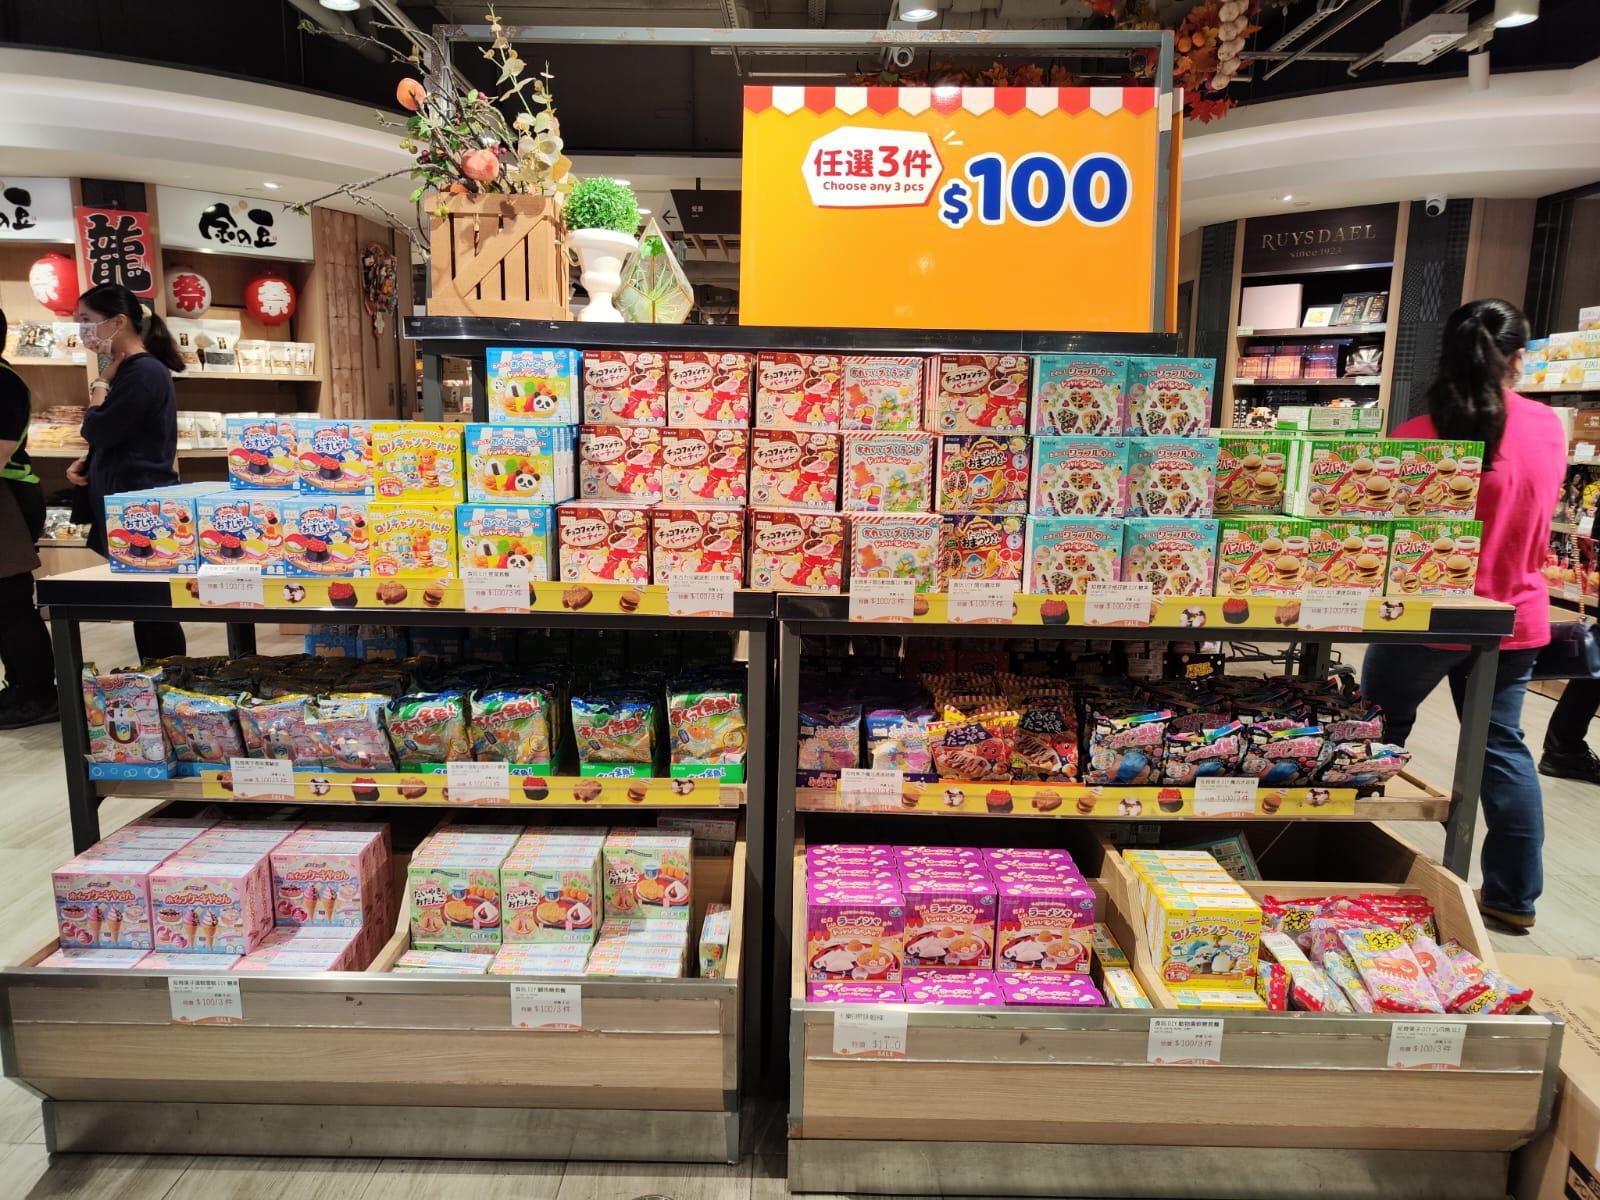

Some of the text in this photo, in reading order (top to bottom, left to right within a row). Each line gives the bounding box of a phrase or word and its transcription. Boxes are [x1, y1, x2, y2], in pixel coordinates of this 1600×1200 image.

[814, 145, 933, 179] 任選3件
[823, 181, 925, 193] Choose any 3 pcs
[943, 156, 1128, 224] $100
[1262, 224, 1376, 251] RUYSDAEL
[172, 275, 207, 312] 祭
[258, 281, 291, 317] 祭
